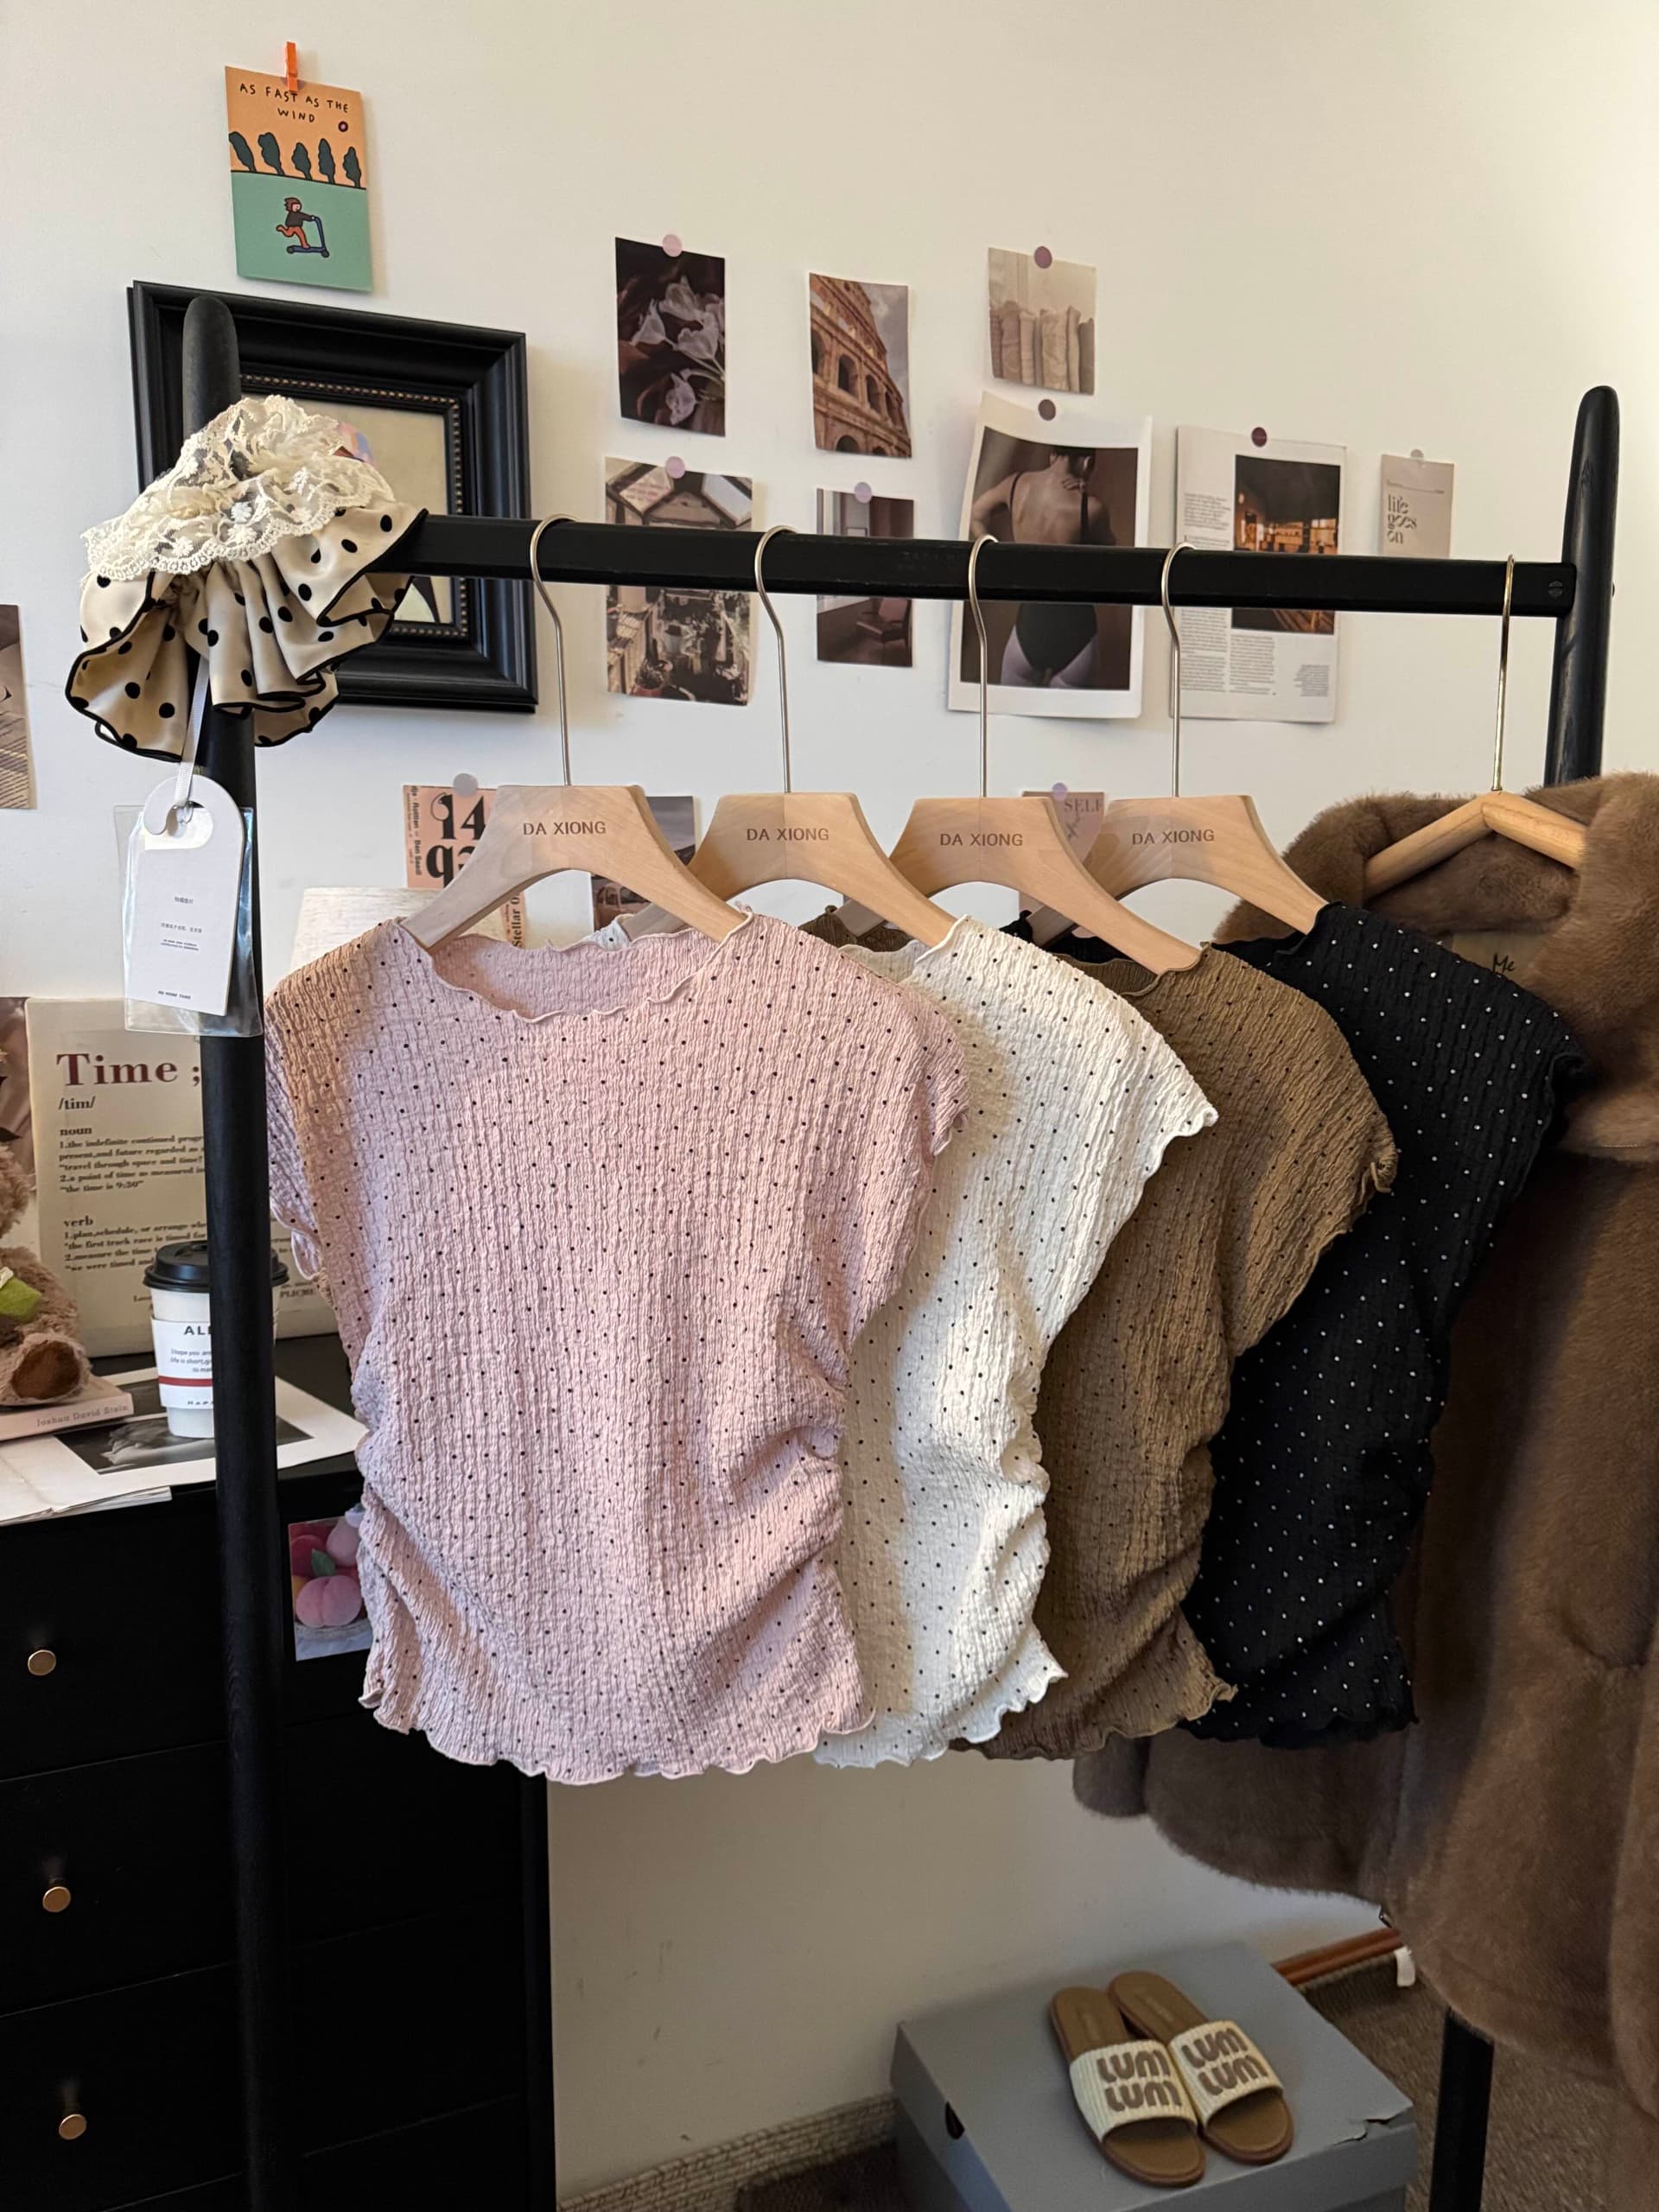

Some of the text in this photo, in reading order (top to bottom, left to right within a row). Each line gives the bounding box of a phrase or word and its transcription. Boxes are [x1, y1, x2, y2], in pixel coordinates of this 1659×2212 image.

[239, 83, 349, 113] AS FAST AS THE
[277, 107, 315, 123] WIND
[1387, 530, 1404, 544] on
[523, 821, 607, 836] DA XIONG
[747, 828, 830, 842] DA XIONG
[939, 833, 1023, 847] DA XIONG
[1132, 829, 1215, 845] DA XIONG
[56, 1052, 178, 1086] Time
[58, 1096, 96, 1110] /tim/
[60, 1128, 92, 1136] noun
[63, 1215, 93, 1227] verb
[73, 1408, 100, 1421] David
[1180, 2027, 1249, 2069] LUM
[1096, 2049, 1171, 2083] LUM
[1198, 2055, 1268, 2096] LUM
[1103, 2081, 1182, 2113] LUM
